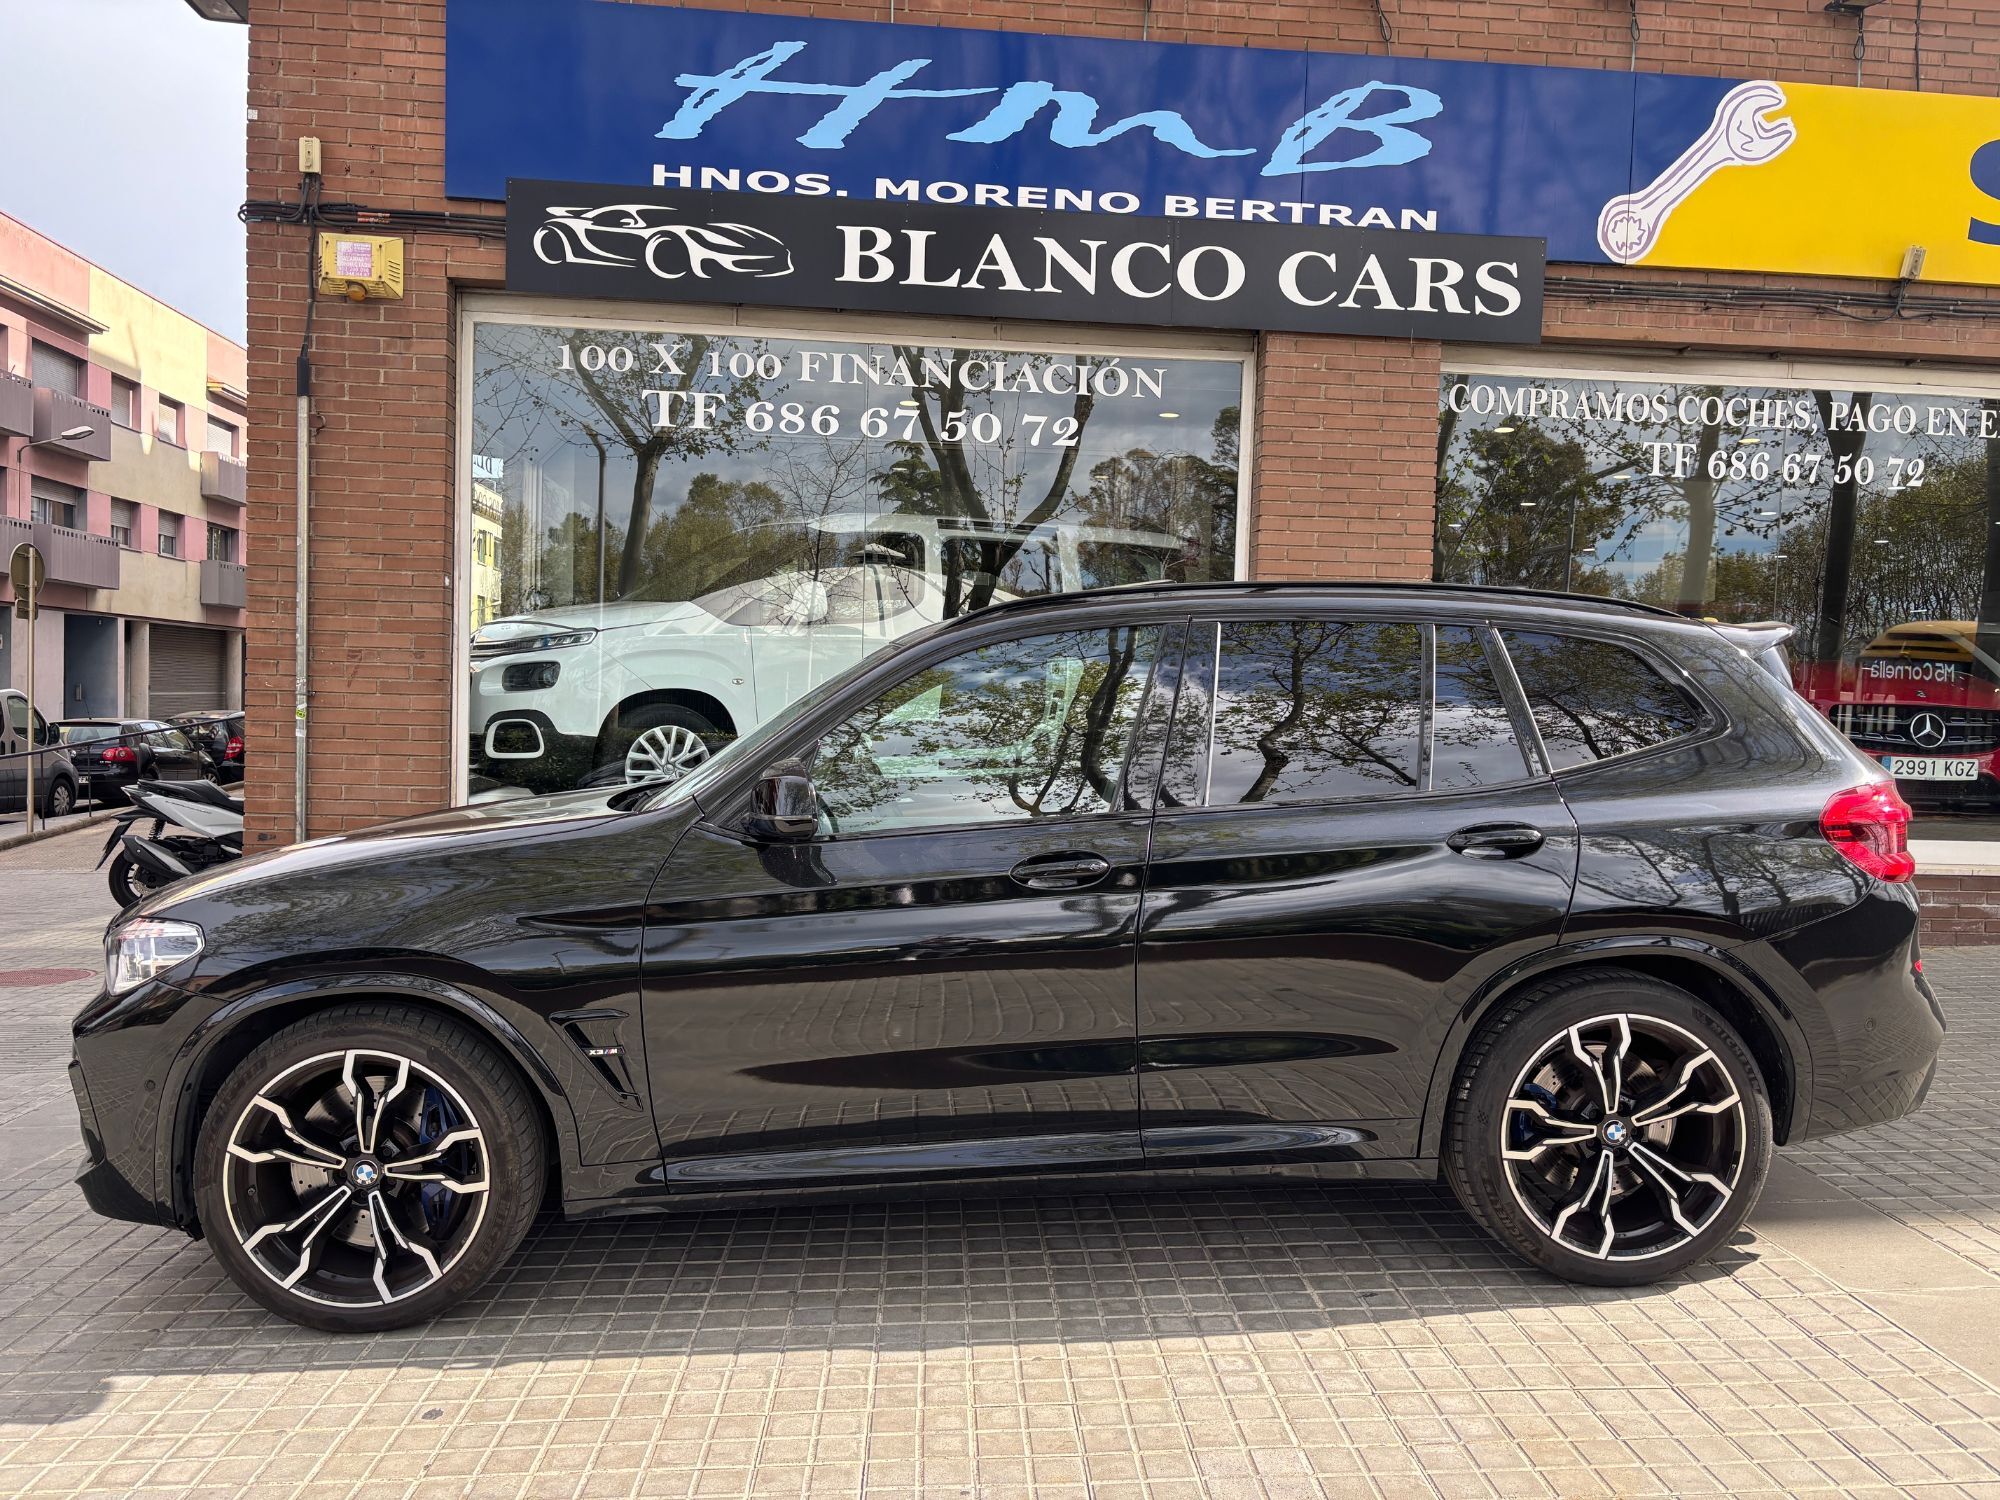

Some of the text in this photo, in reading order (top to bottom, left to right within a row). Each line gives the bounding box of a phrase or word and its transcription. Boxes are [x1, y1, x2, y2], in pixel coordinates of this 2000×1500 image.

[653, 164, 1437, 232] HNOS. MORENO BERTRAN
[834, 225, 1521, 317] BLANCO CARS
[557, 343, 1168, 399] 100 X 100 FINANCIACIÓN
[641, 389, 1079, 447] TF 686 67 50 72
[1449, 383, 2000, 439] COMPRAMOS COCHES, PAGO EN E
[1642, 441, 1925, 488] TF 686 67 50 72
[1894, 759, 1976, 777] 2991 KGZ
